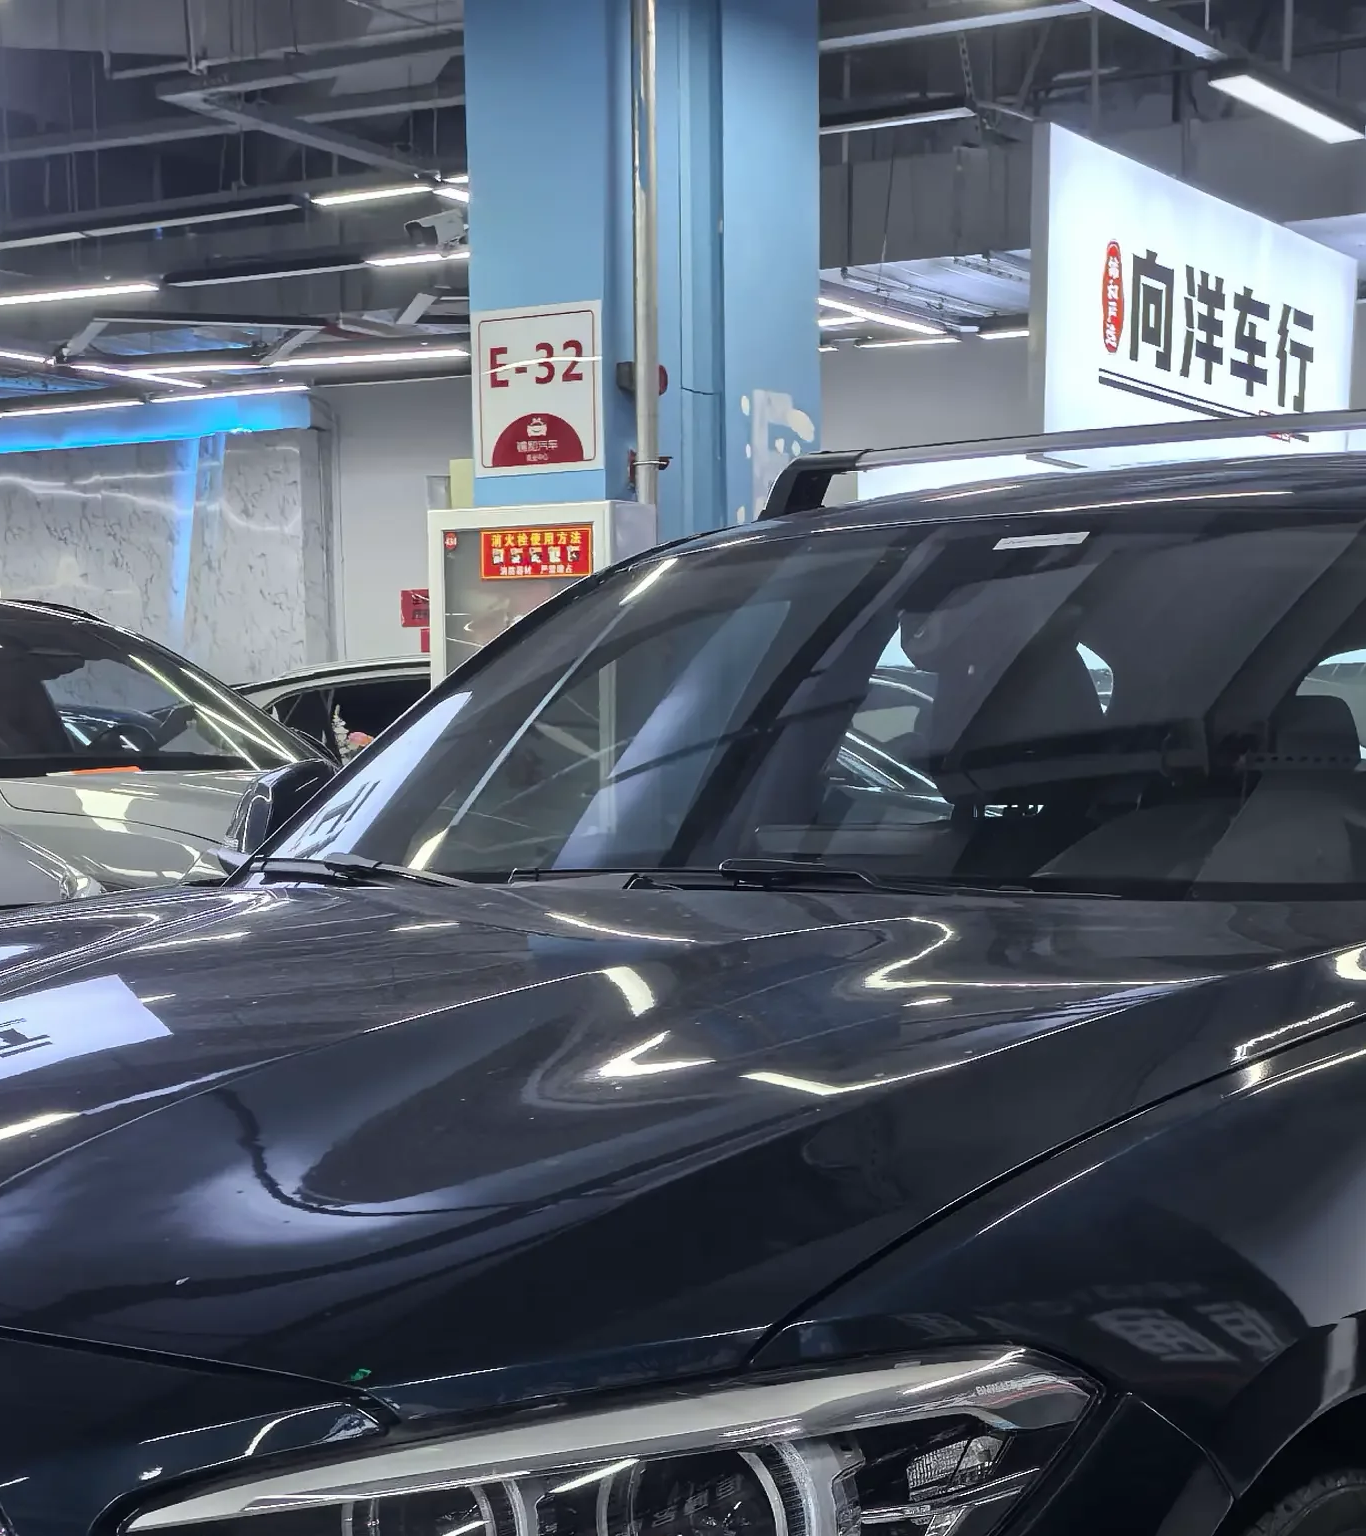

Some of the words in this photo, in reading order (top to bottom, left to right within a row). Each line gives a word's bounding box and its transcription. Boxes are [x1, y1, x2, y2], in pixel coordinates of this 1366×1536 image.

[1129, 249, 1314, 413] 向洋车行
[489, 339, 584, 389] E-32
[491, 531, 583, 547] 消火栓使用方法
